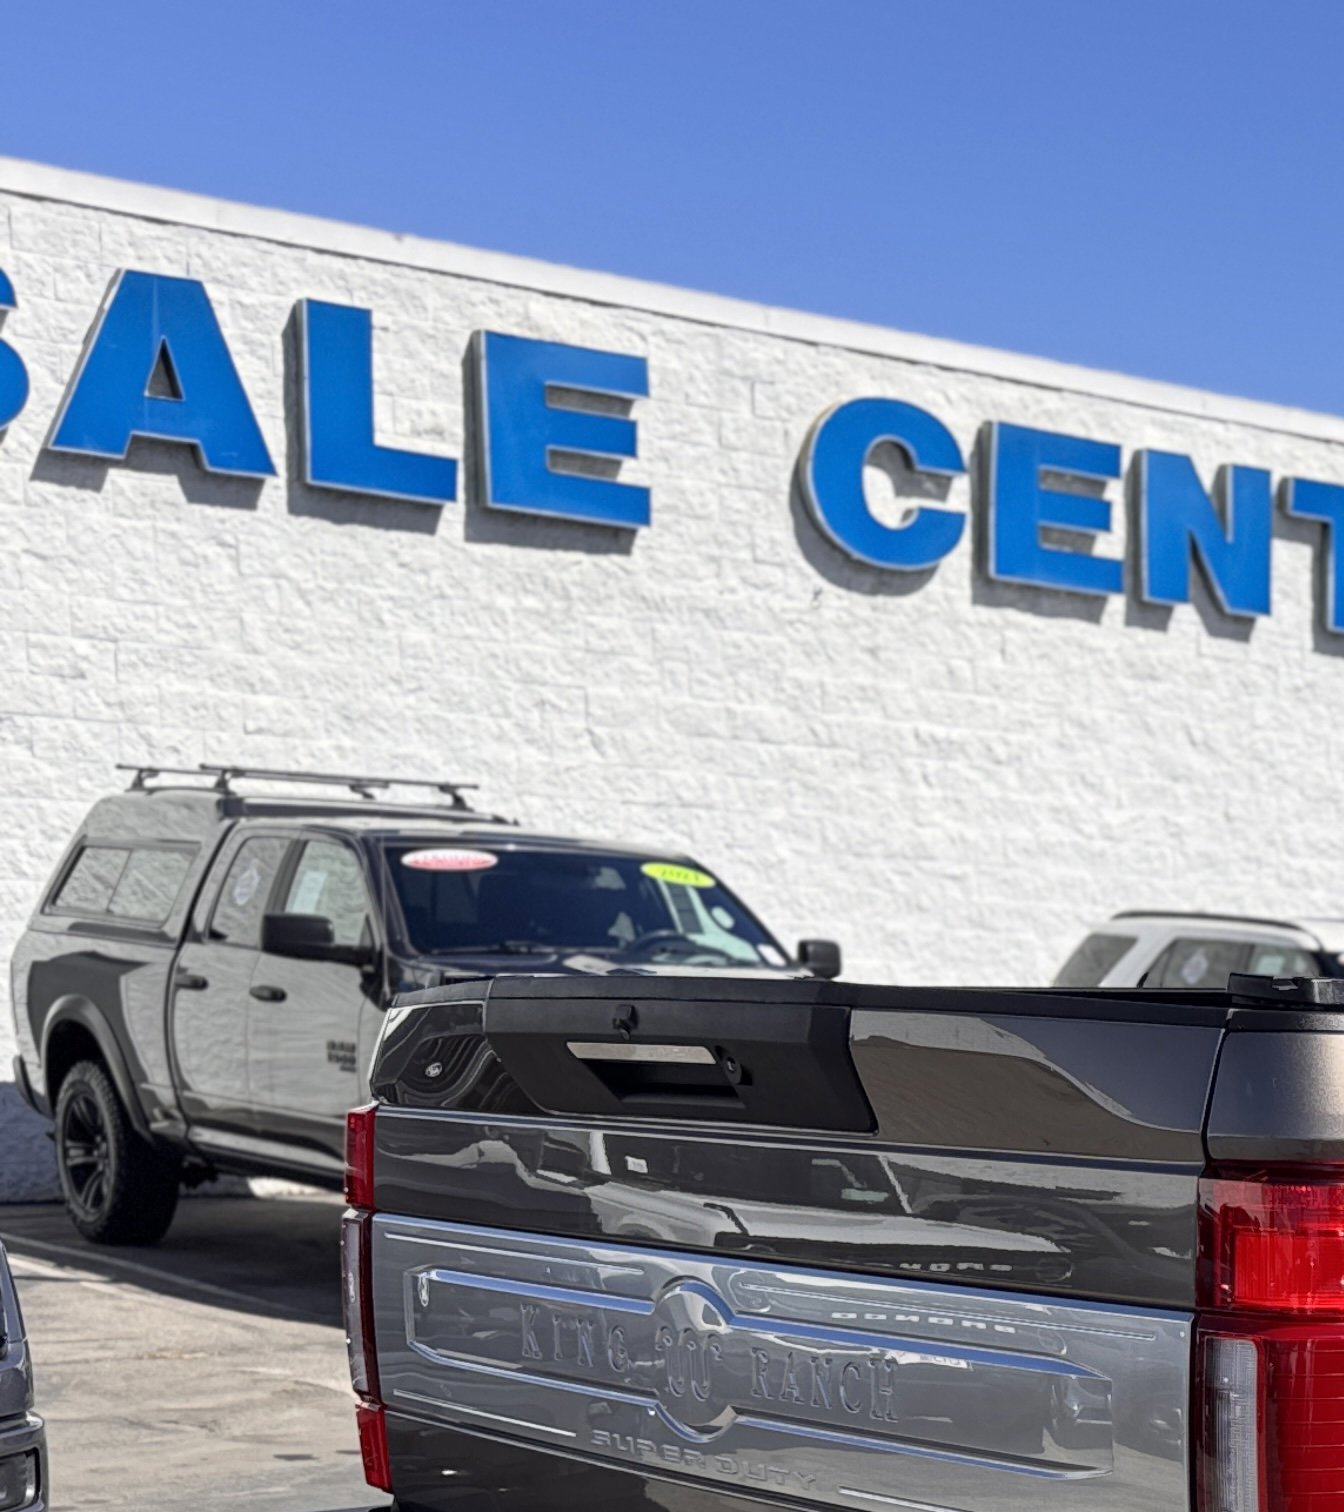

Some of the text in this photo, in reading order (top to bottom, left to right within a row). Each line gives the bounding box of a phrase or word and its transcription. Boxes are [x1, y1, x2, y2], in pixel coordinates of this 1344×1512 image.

[0, 264, 652, 529] ALE
[519, 1302, 900, 1424] KING RANCH
[590, 1428, 818, 1491] SUPER DUTY
